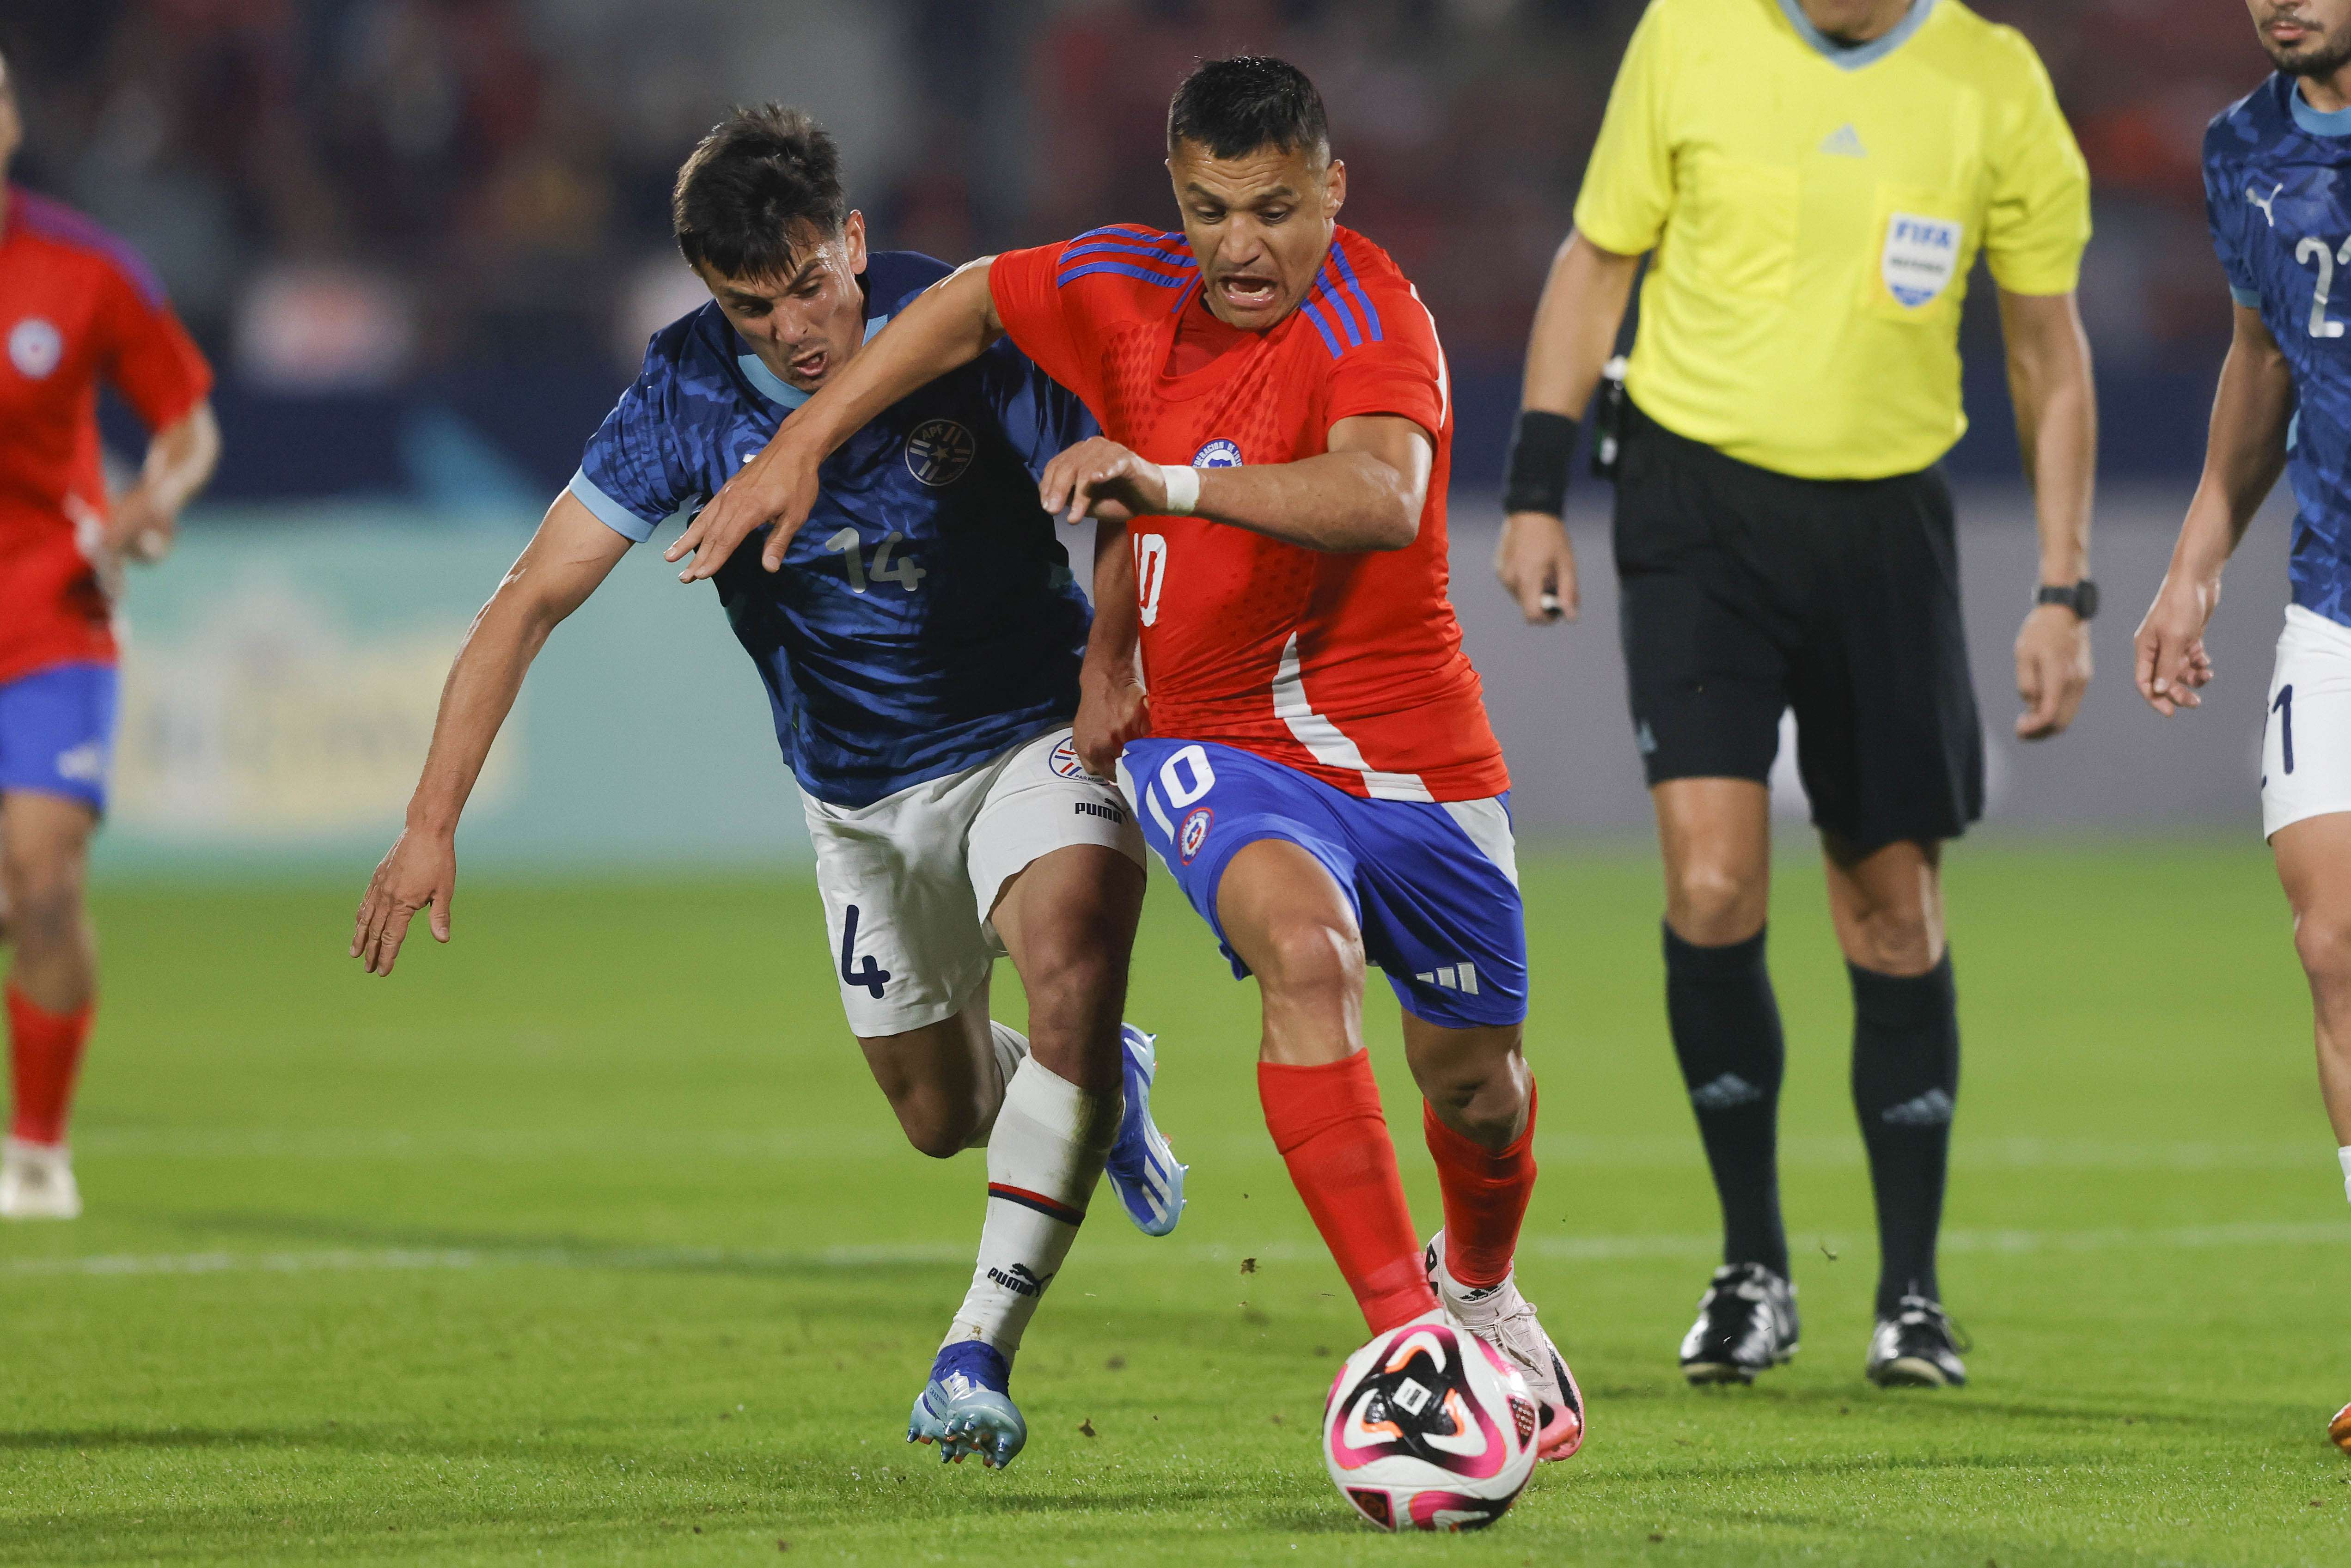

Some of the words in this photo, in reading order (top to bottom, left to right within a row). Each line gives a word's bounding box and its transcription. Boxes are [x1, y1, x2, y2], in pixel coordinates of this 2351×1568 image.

[1896, 220, 1950, 248] FIFA
[825, 527, 927, 593] 14
[1075, 802, 1123, 824] PUMA
[841, 904, 891, 999] 4
[987, 1267, 1036, 1297] PUMA
